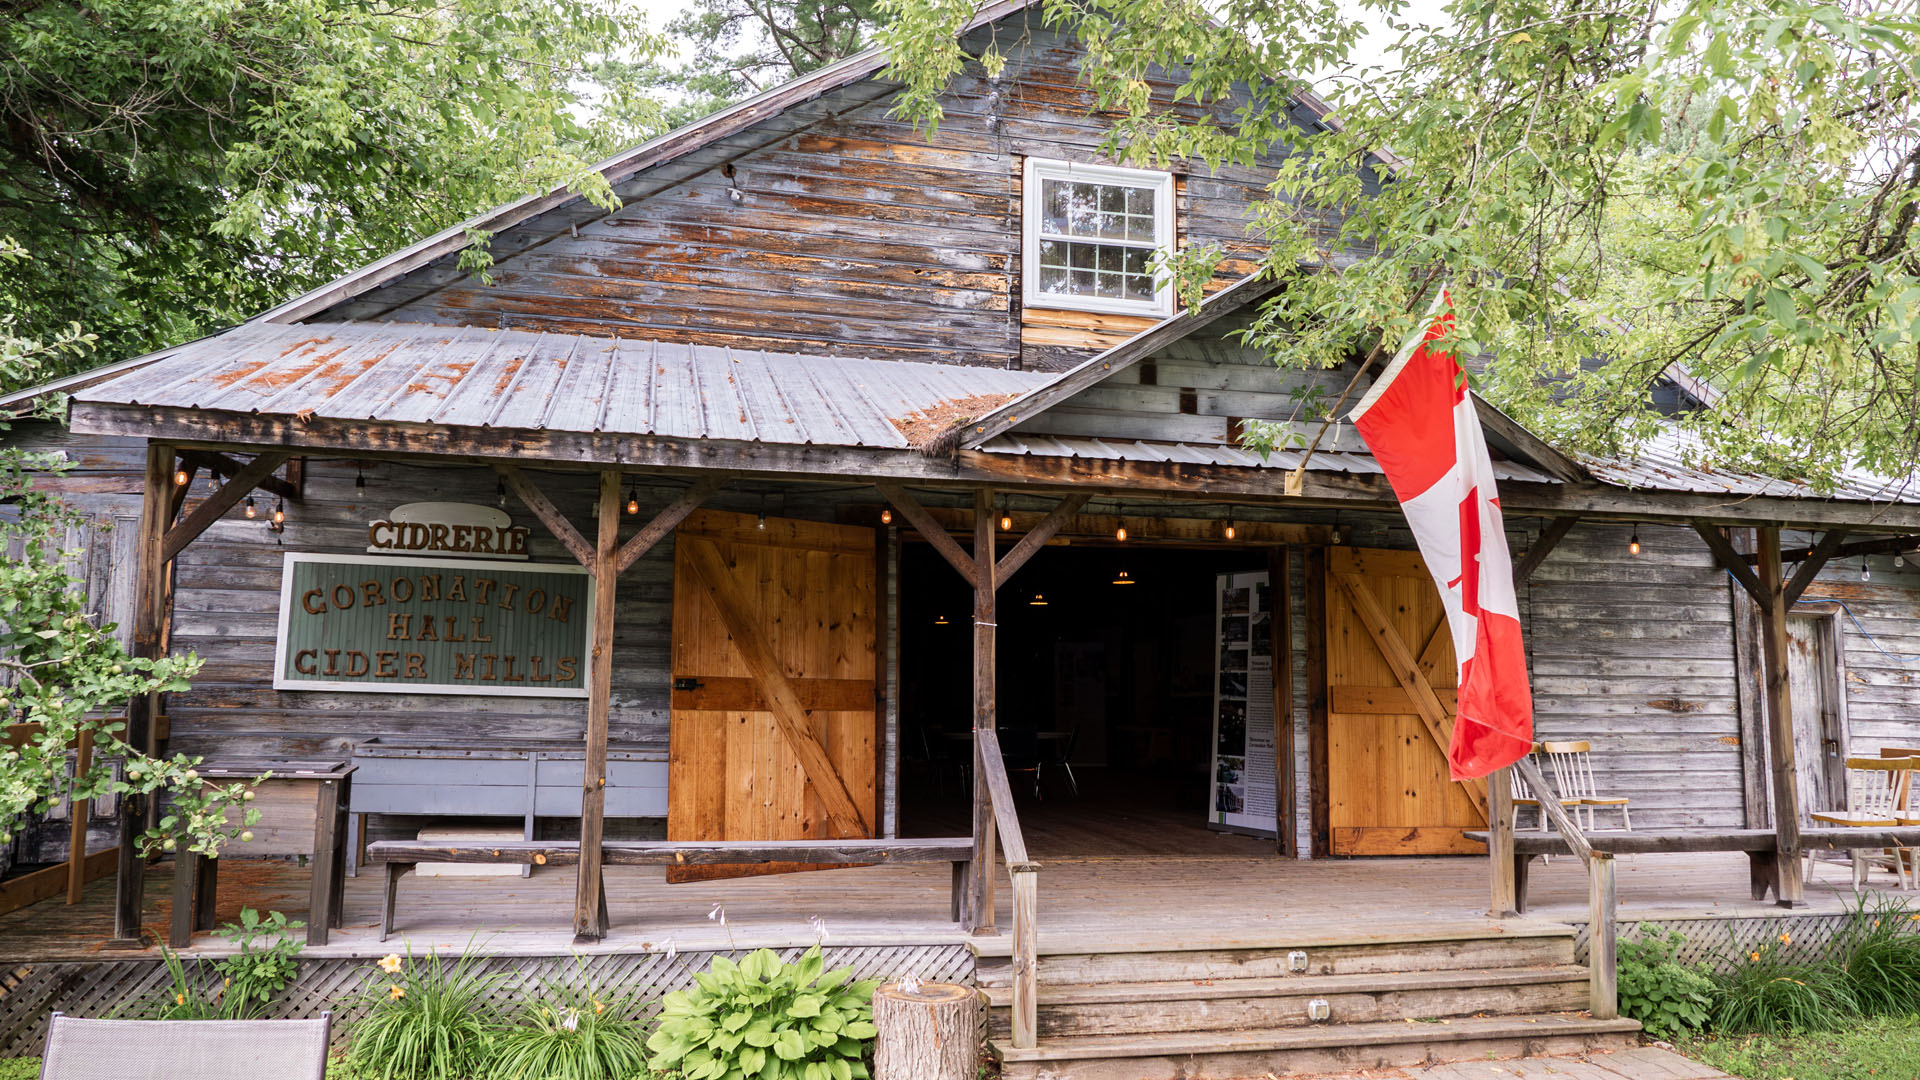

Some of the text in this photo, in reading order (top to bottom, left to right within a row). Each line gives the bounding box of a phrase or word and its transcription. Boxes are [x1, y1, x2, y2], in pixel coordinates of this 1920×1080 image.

[368, 521, 530, 555] CIDRERIE
[302, 574, 573, 622] CORONATION
[387, 613, 493, 643] HALL
[294, 649, 578, 683] CIDER MILLS
